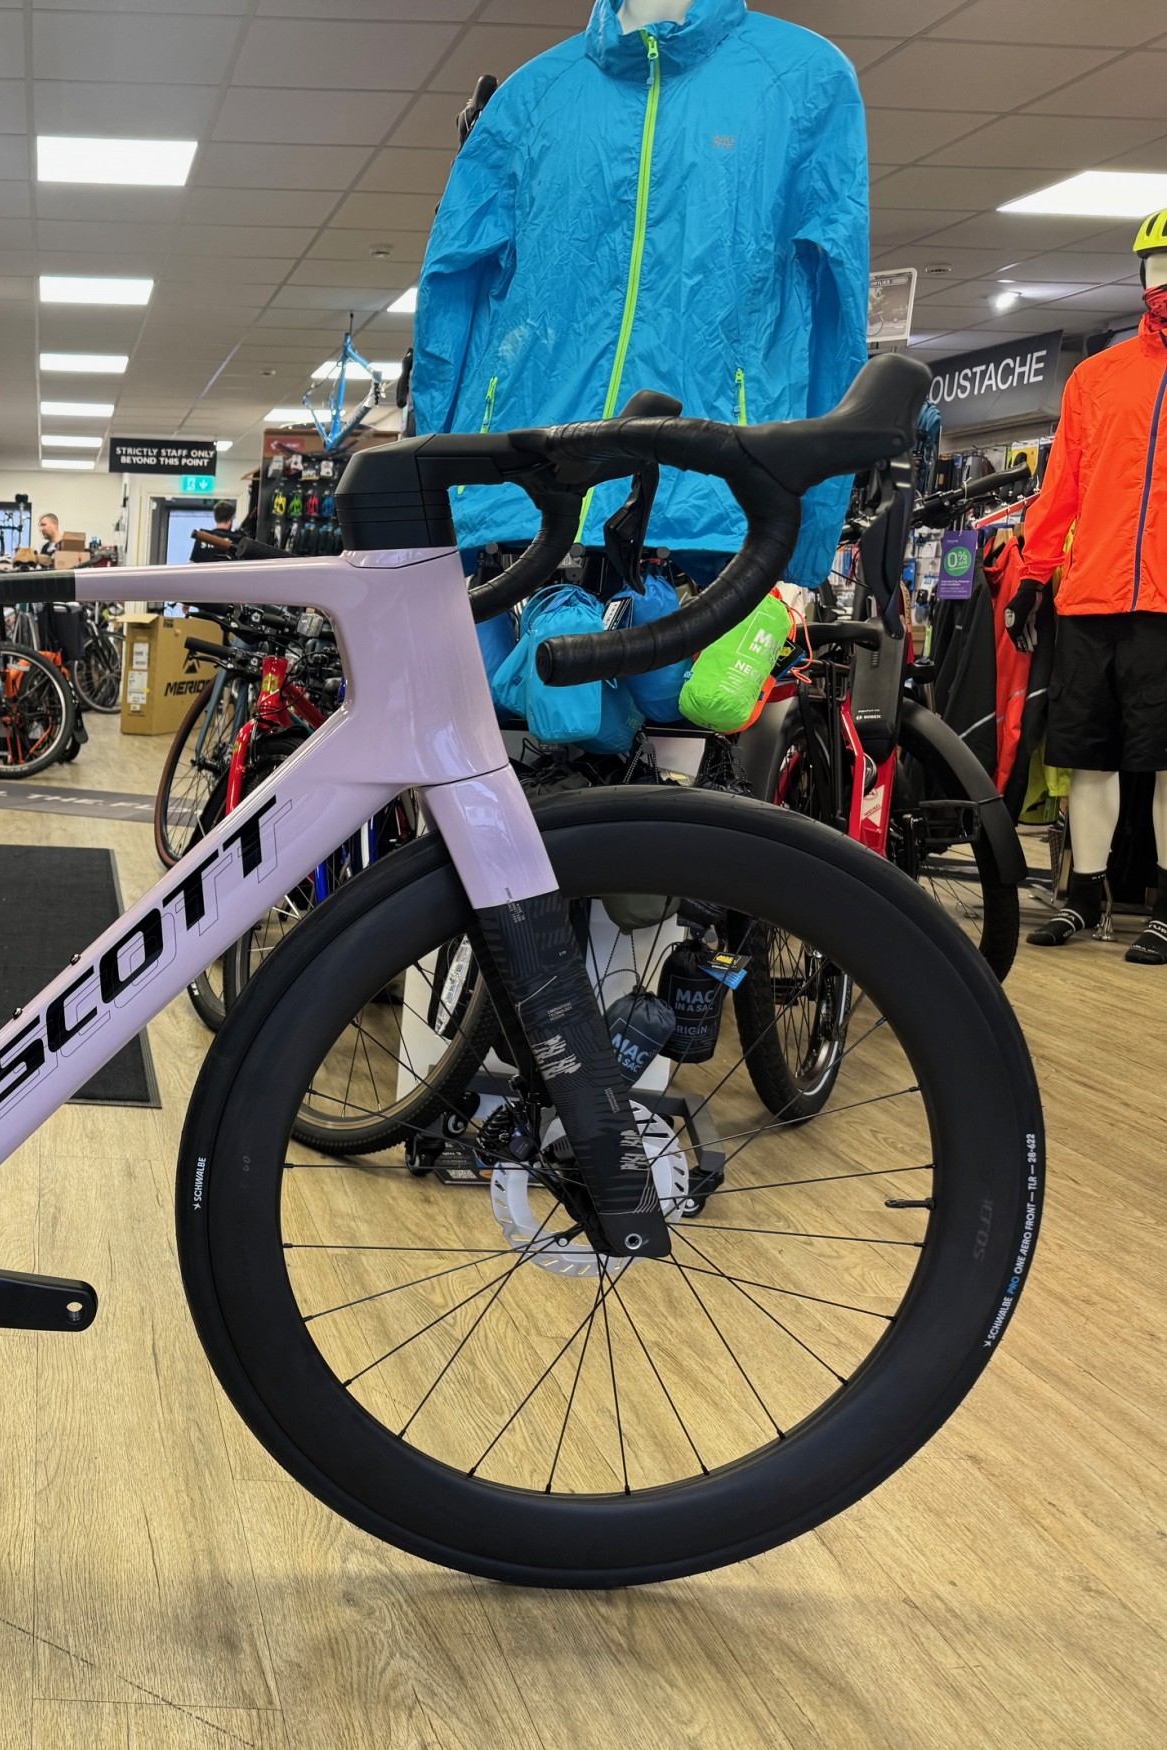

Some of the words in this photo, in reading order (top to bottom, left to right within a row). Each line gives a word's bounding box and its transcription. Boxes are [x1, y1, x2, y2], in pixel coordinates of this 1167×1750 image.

[929, 350, 1047, 405] OUSTACHE
[115, 446, 158, 456] STRICTLY
[160, 448, 188, 457] STAFF
[190, 449, 215, 458] ONLY
[120, 455, 157, 465] BEYOND
[159, 457, 179, 466] THIS
[181, 458, 209, 467] POINT
[675, 988, 715, 1004] MAC
[675, 1002, 684, 1010] IN
[686, 1003, 695, 1012] A
[676, 1025, 708, 1036] RIGIN
[612, 1033, 649, 1065] MAC
[622, 1058, 643, 1073] SAC
[1026, 1133, 1037, 1163] 28-622
[194, 1157, 207, 1202] SCHWALBE
[1027, 1176, 1037, 1190] TLR
[1024, 1203, 1036, 1231] FRONT
[1021, 1231, 1032, 1256] AERO
[1013, 1255, 1025, 1275] ONE
[1006, 1275, 1020, 1295] PRO
[987, 1296, 1014, 1340] SCHWALBE
